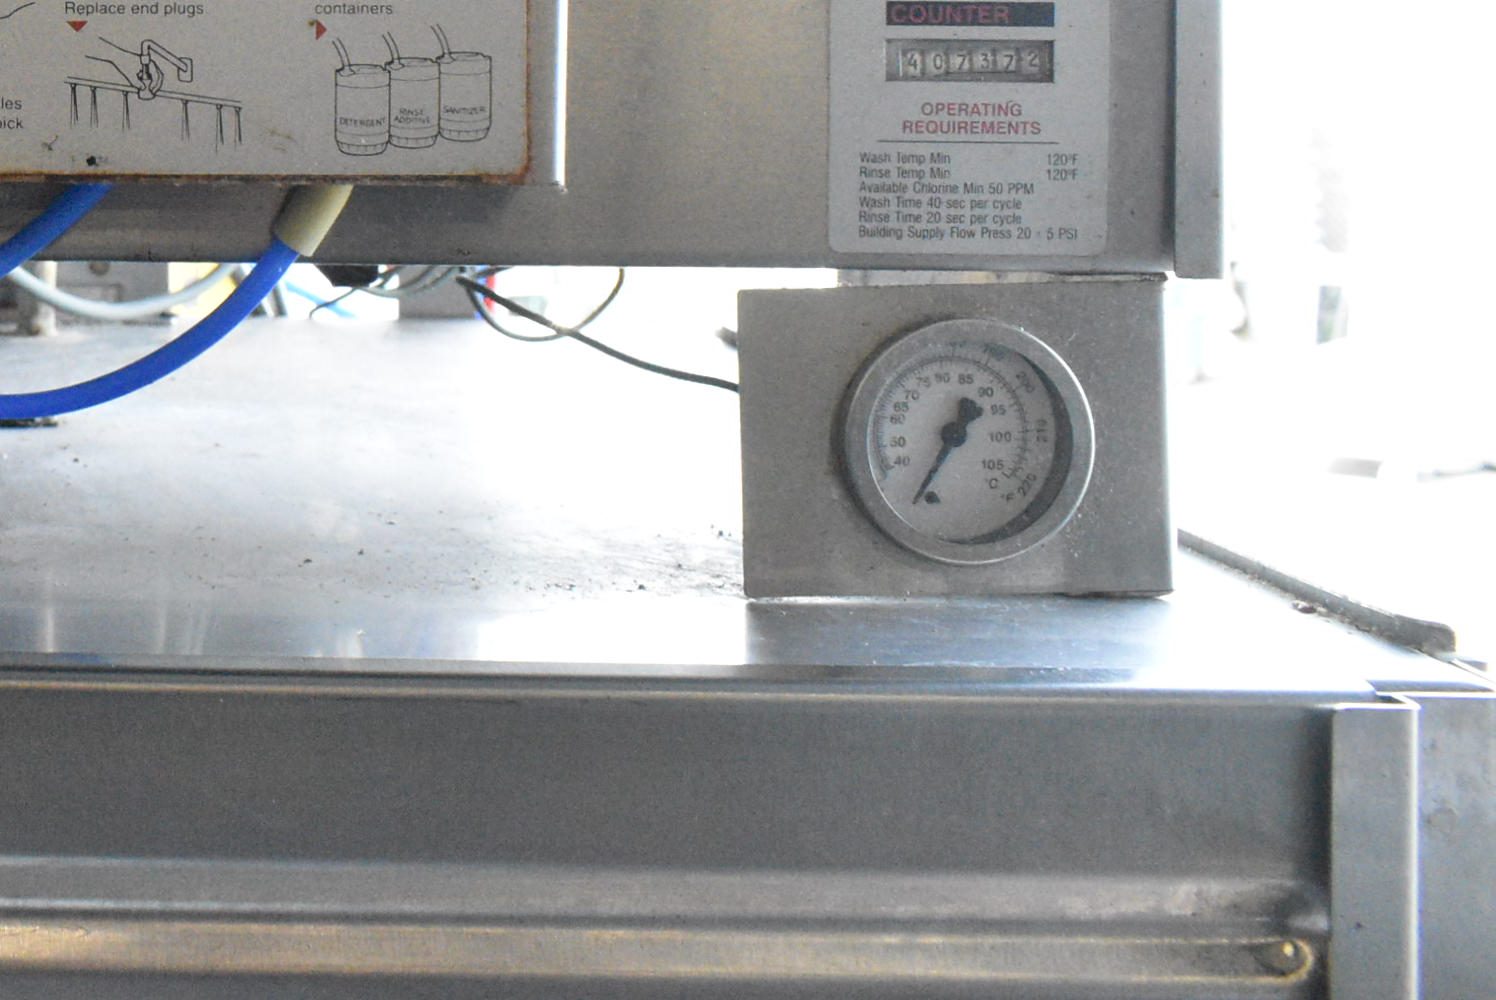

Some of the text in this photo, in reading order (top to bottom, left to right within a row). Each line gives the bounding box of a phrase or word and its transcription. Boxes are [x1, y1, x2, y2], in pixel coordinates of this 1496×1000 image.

[65, 1, 125, 16] Replace
[131, 2, 159, 14] end
[889, 5, 1010, 24] COUNTER
[921, 100, 1022, 117] OPERATING
[902, 120, 1041, 135] REQUIREMENTS
[859, 195, 1022, 211] Wash Time 40 sec per cycle
[859, 210, 1021, 227] Rinse Time 20 sec per cycle
[958, 374, 974, 385] 85
[978, 387, 994, 397] 90
[991, 404, 1007, 416] 95
[989, 430, 1012, 443] 100
[982, 459, 1005, 471] 105
